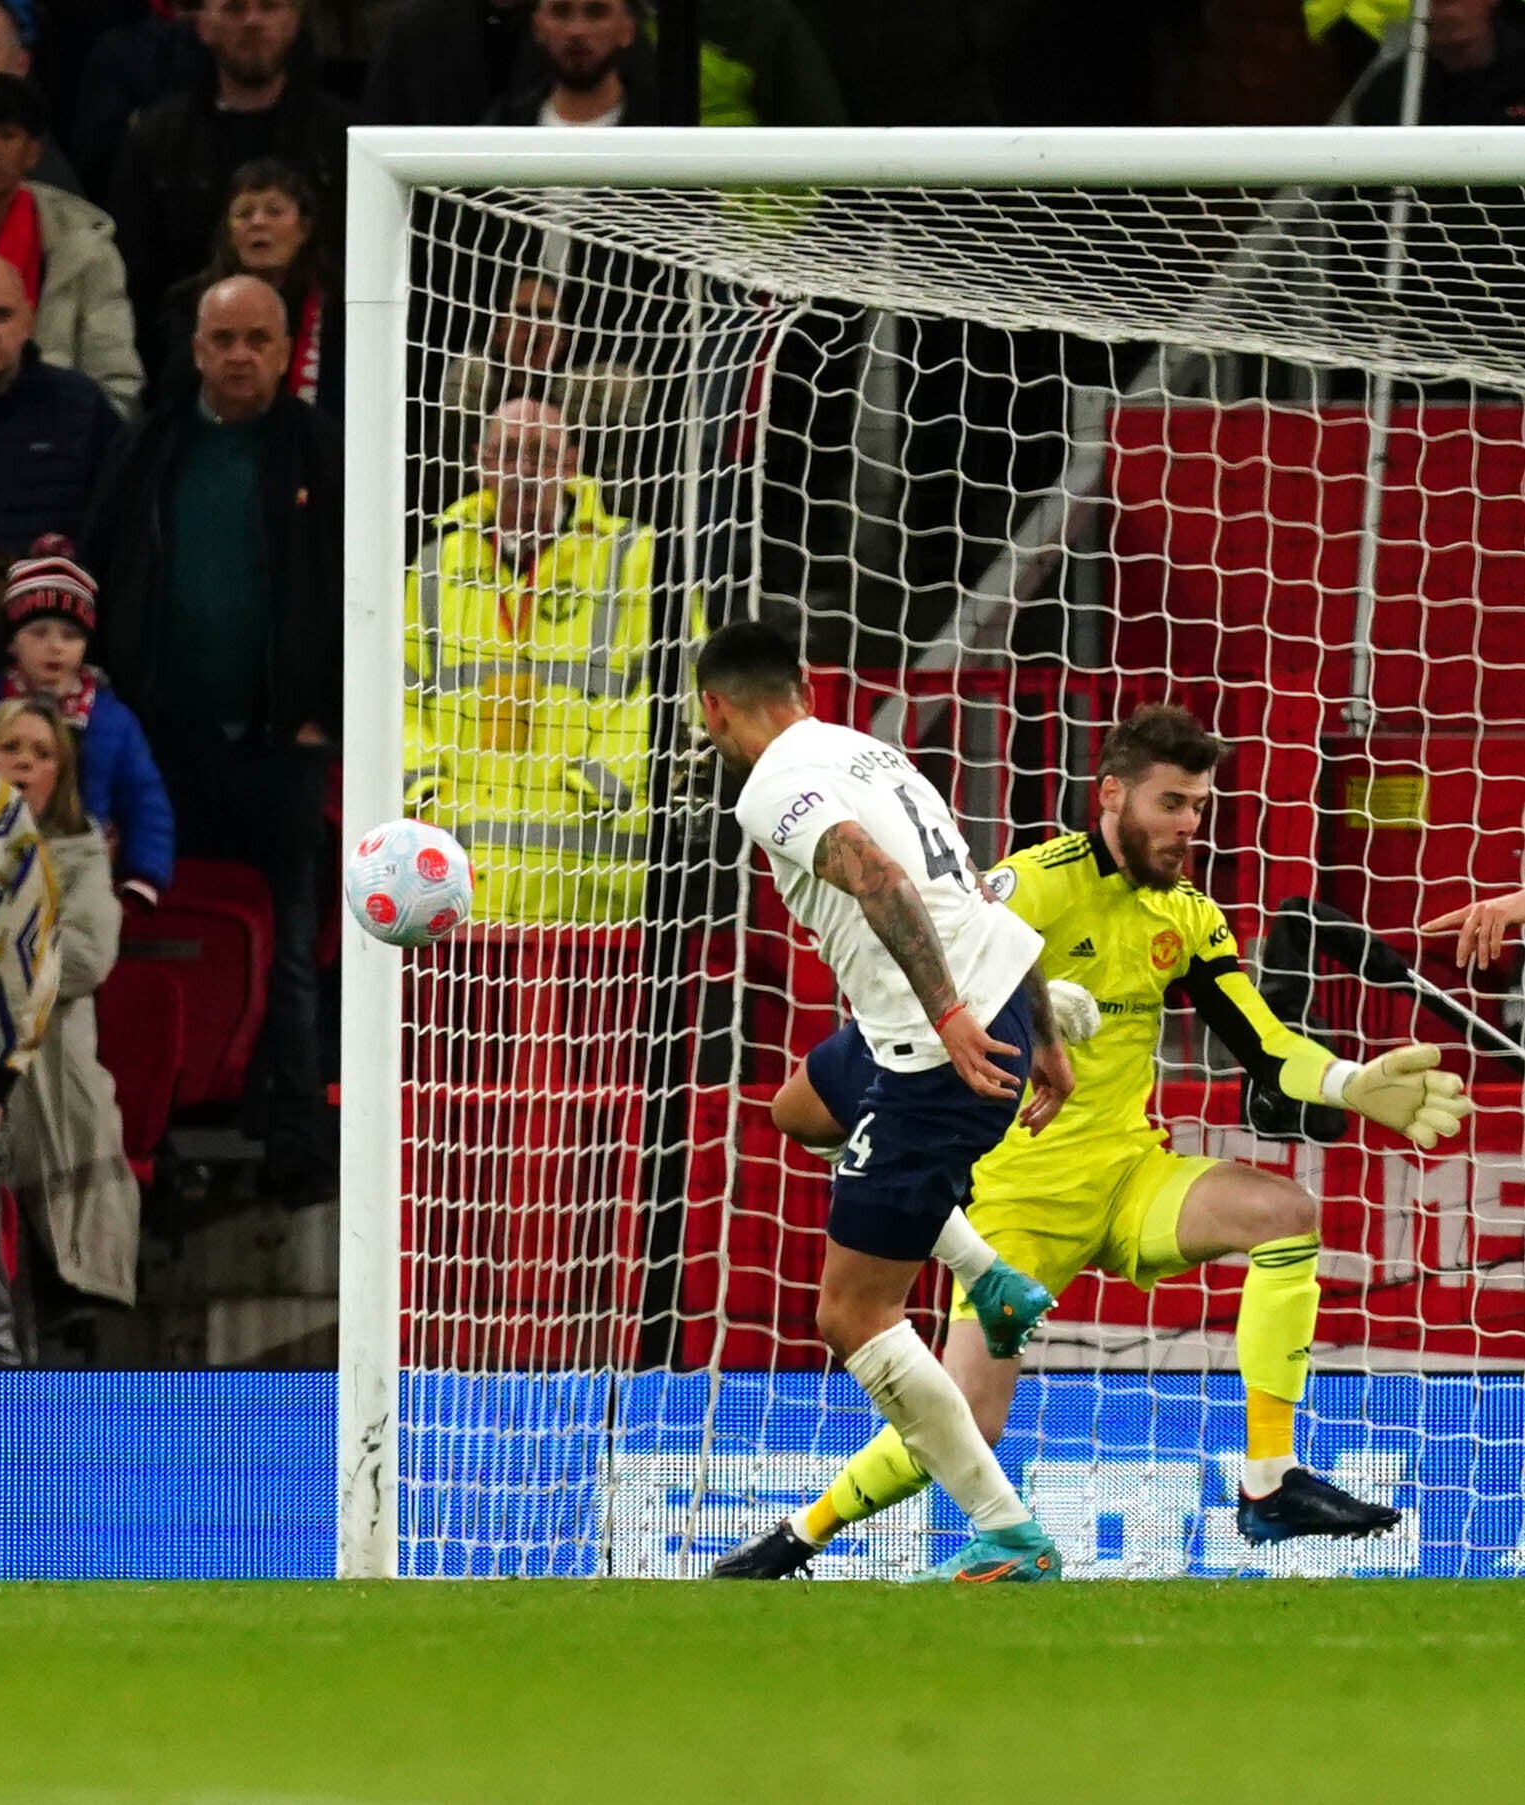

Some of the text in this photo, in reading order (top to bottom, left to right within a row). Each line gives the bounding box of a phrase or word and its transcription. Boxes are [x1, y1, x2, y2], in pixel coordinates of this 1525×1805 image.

[771, 791, 824, 846] cinch
[893, 784, 970, 894] 4
[847, 1112, 876, 1168] 4
